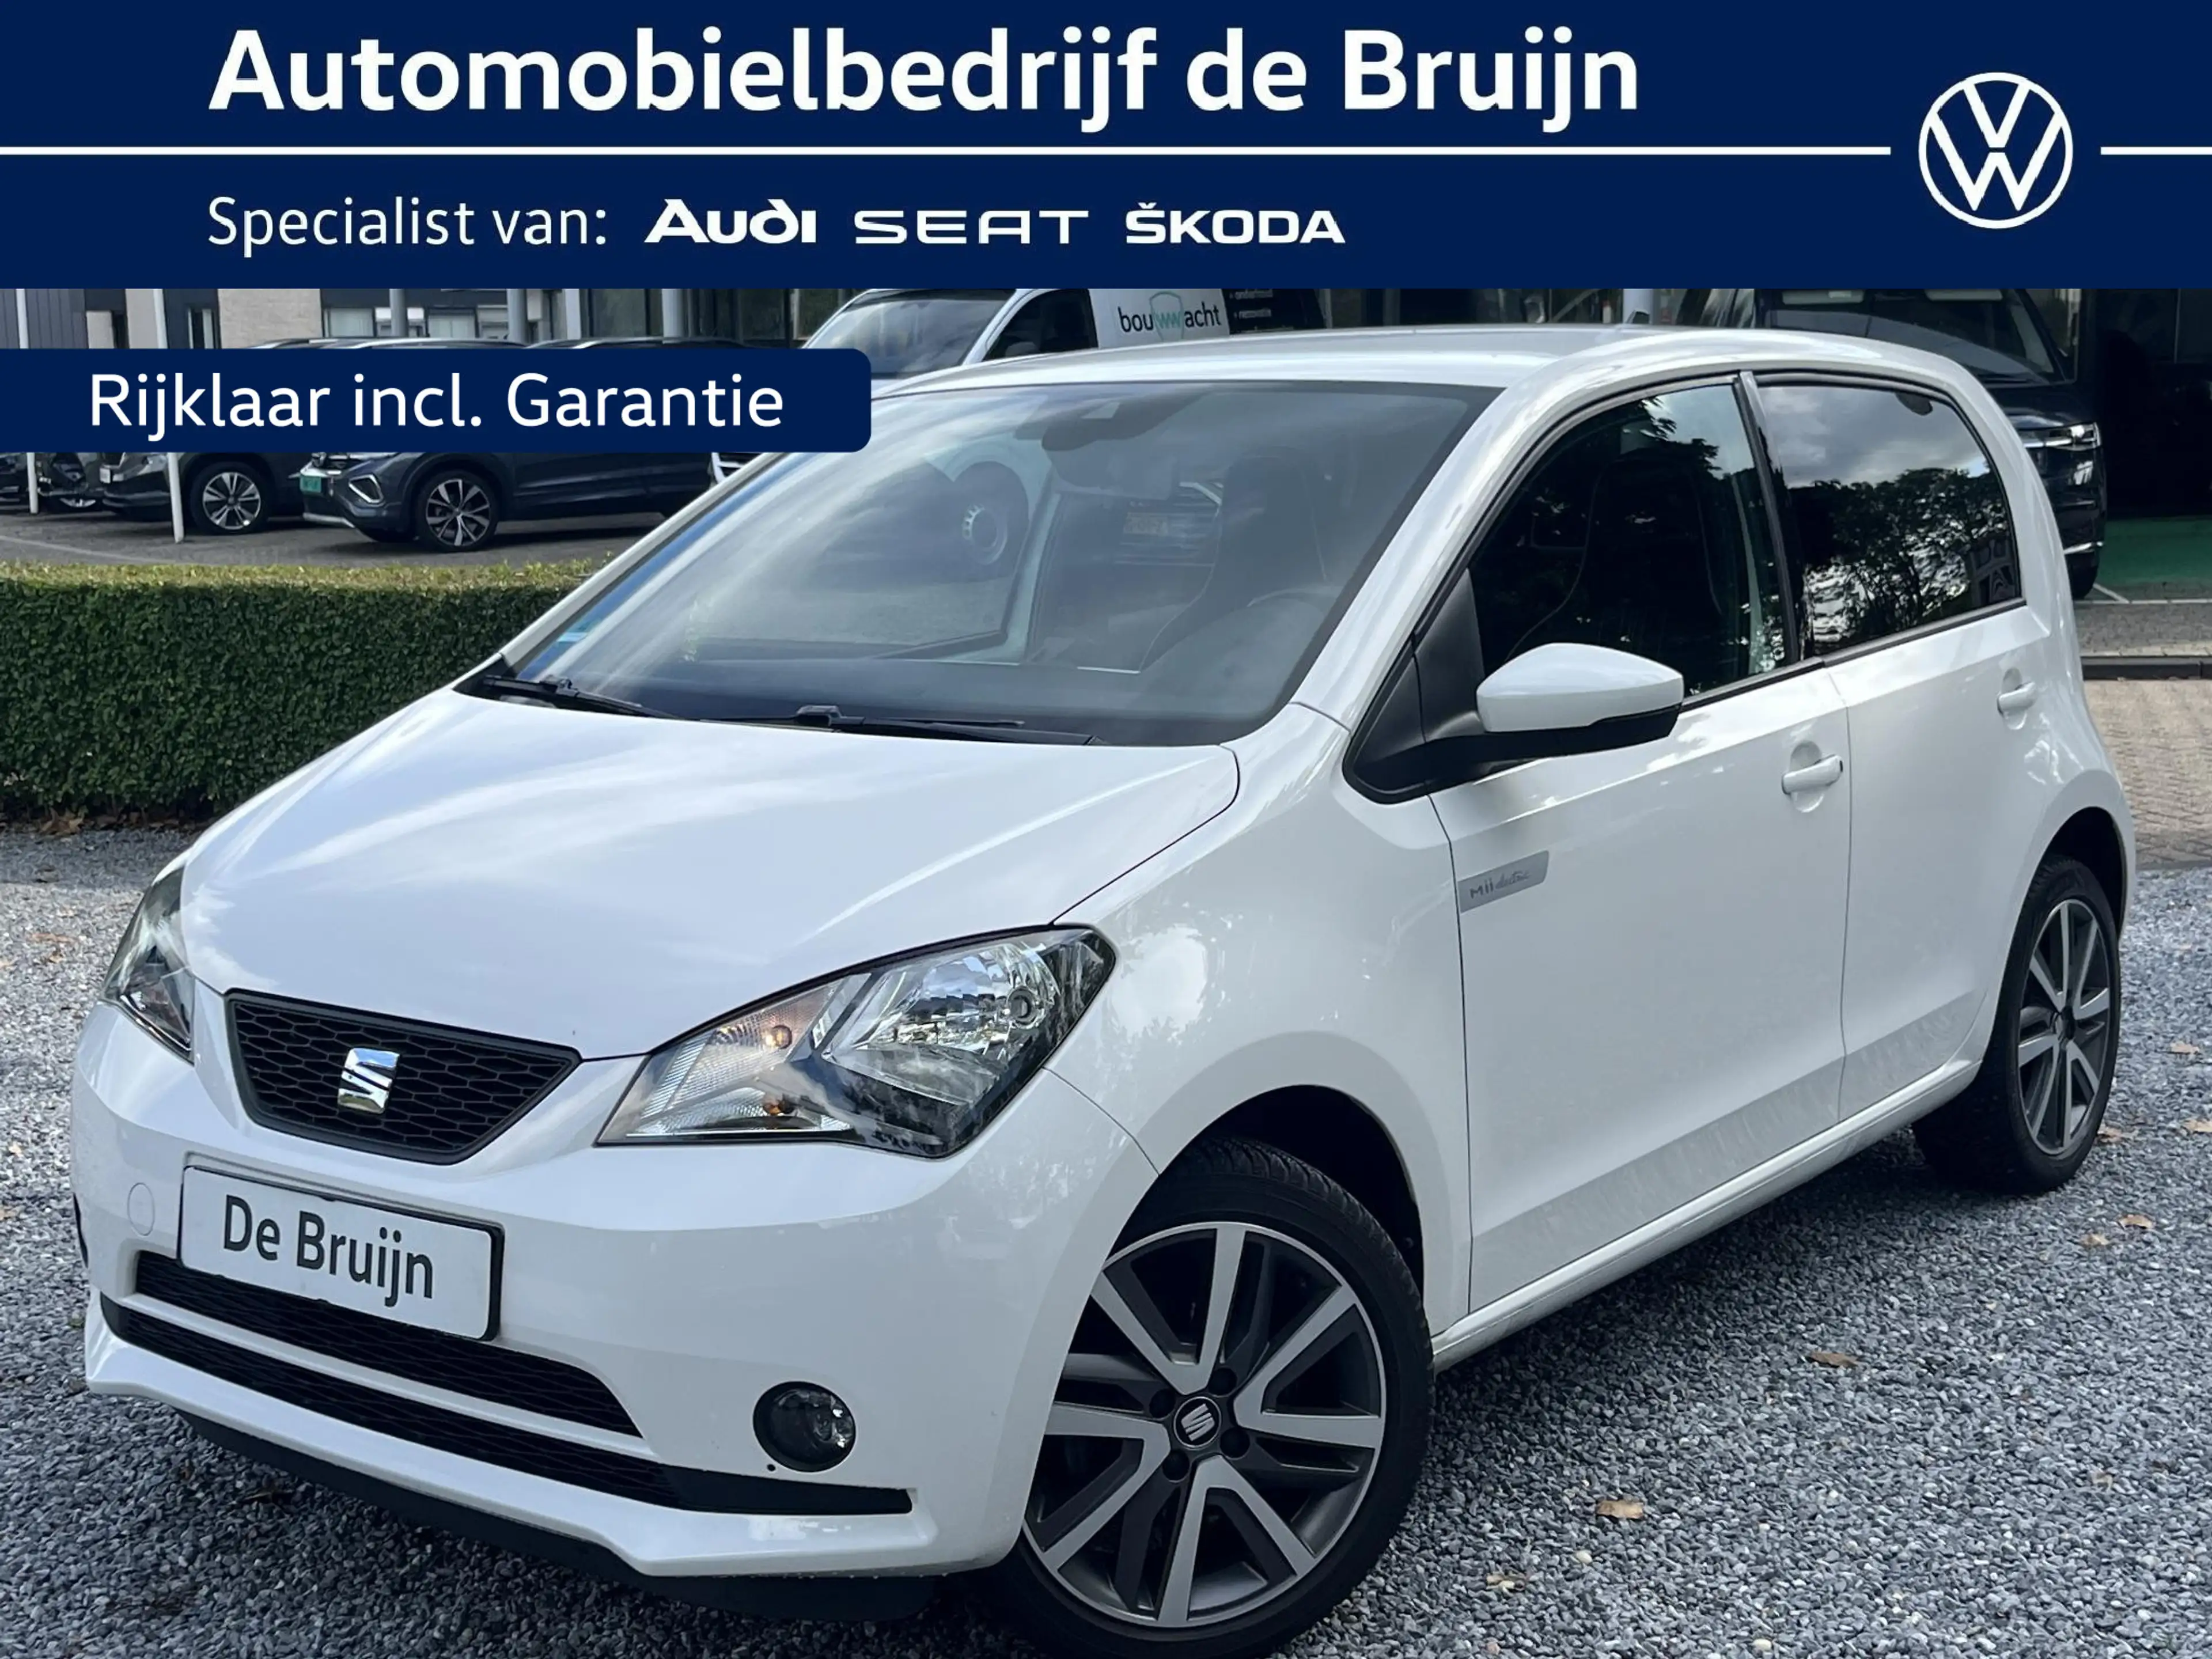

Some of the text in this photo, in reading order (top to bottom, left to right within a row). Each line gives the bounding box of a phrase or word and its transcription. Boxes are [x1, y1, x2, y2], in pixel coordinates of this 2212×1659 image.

[1118, 300, 1222, 332] bouwwacht
[224, 1195, 434, 1307] De Bruijn
